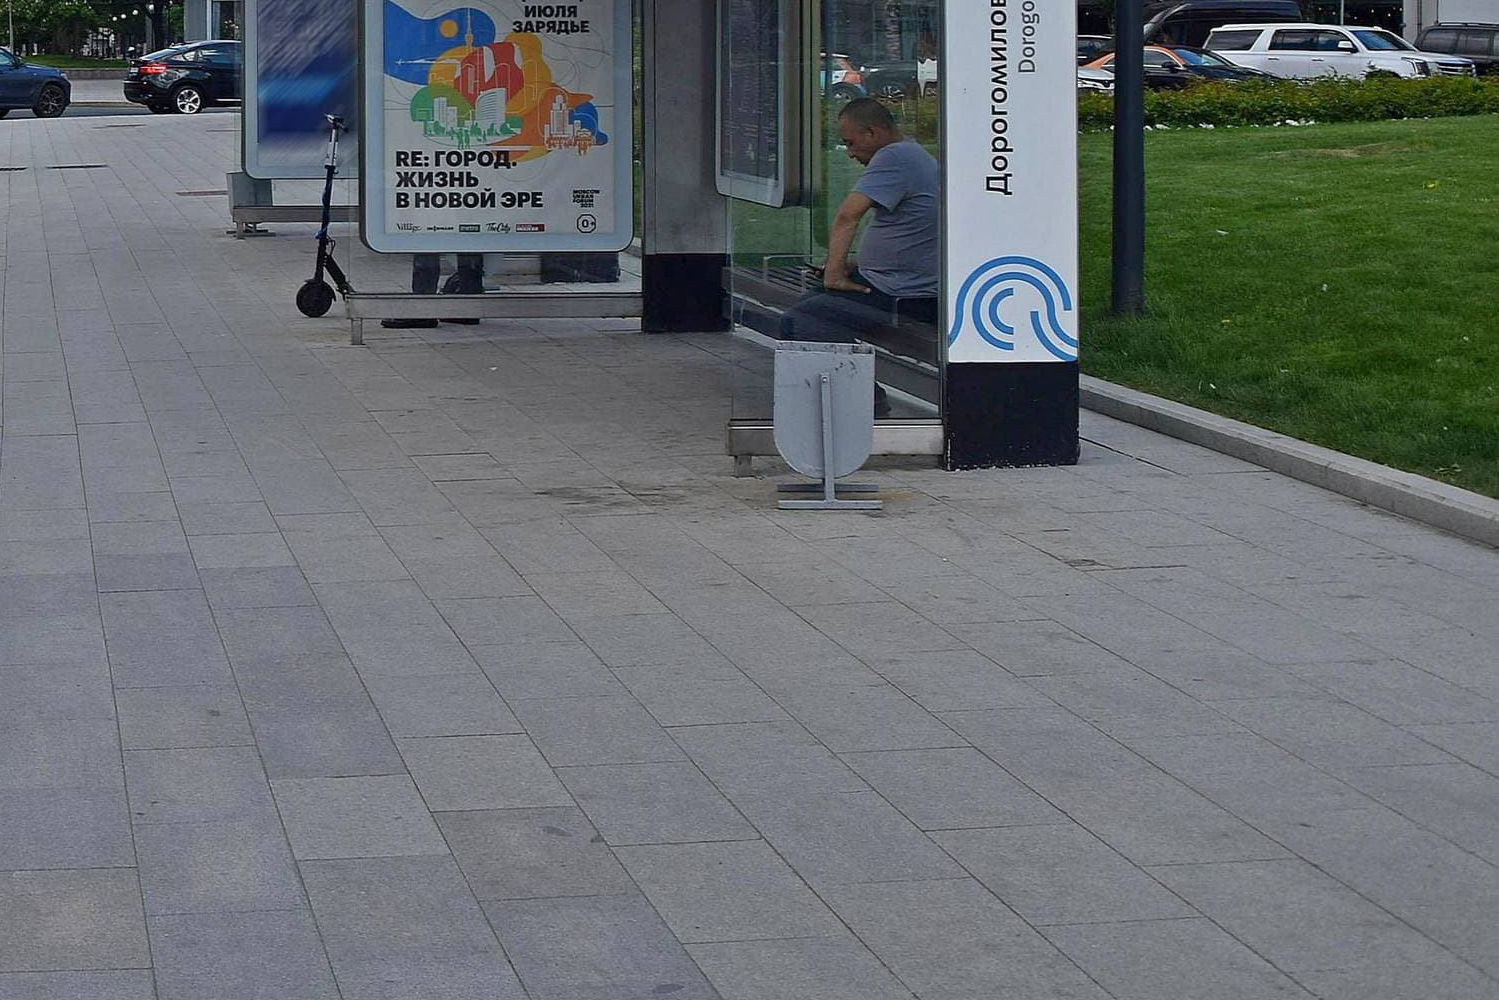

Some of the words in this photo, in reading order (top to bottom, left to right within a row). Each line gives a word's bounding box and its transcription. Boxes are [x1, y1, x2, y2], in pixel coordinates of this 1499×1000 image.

[524, 5, 578, 18] ИЮЛЯ
[512, 20, 590, 34] ЗАРЯДЬЕ
[395, 151, 429, 167] RE:
[434, 150, 517, 169] ГОРОД.
[395, 172, 479, 188] ЖИЗНЬ
[395, 193, 410, 208] В
[415, 187, 497, 209] НОВОЙ
[501, 192, 544, 209] ЭРЕ
